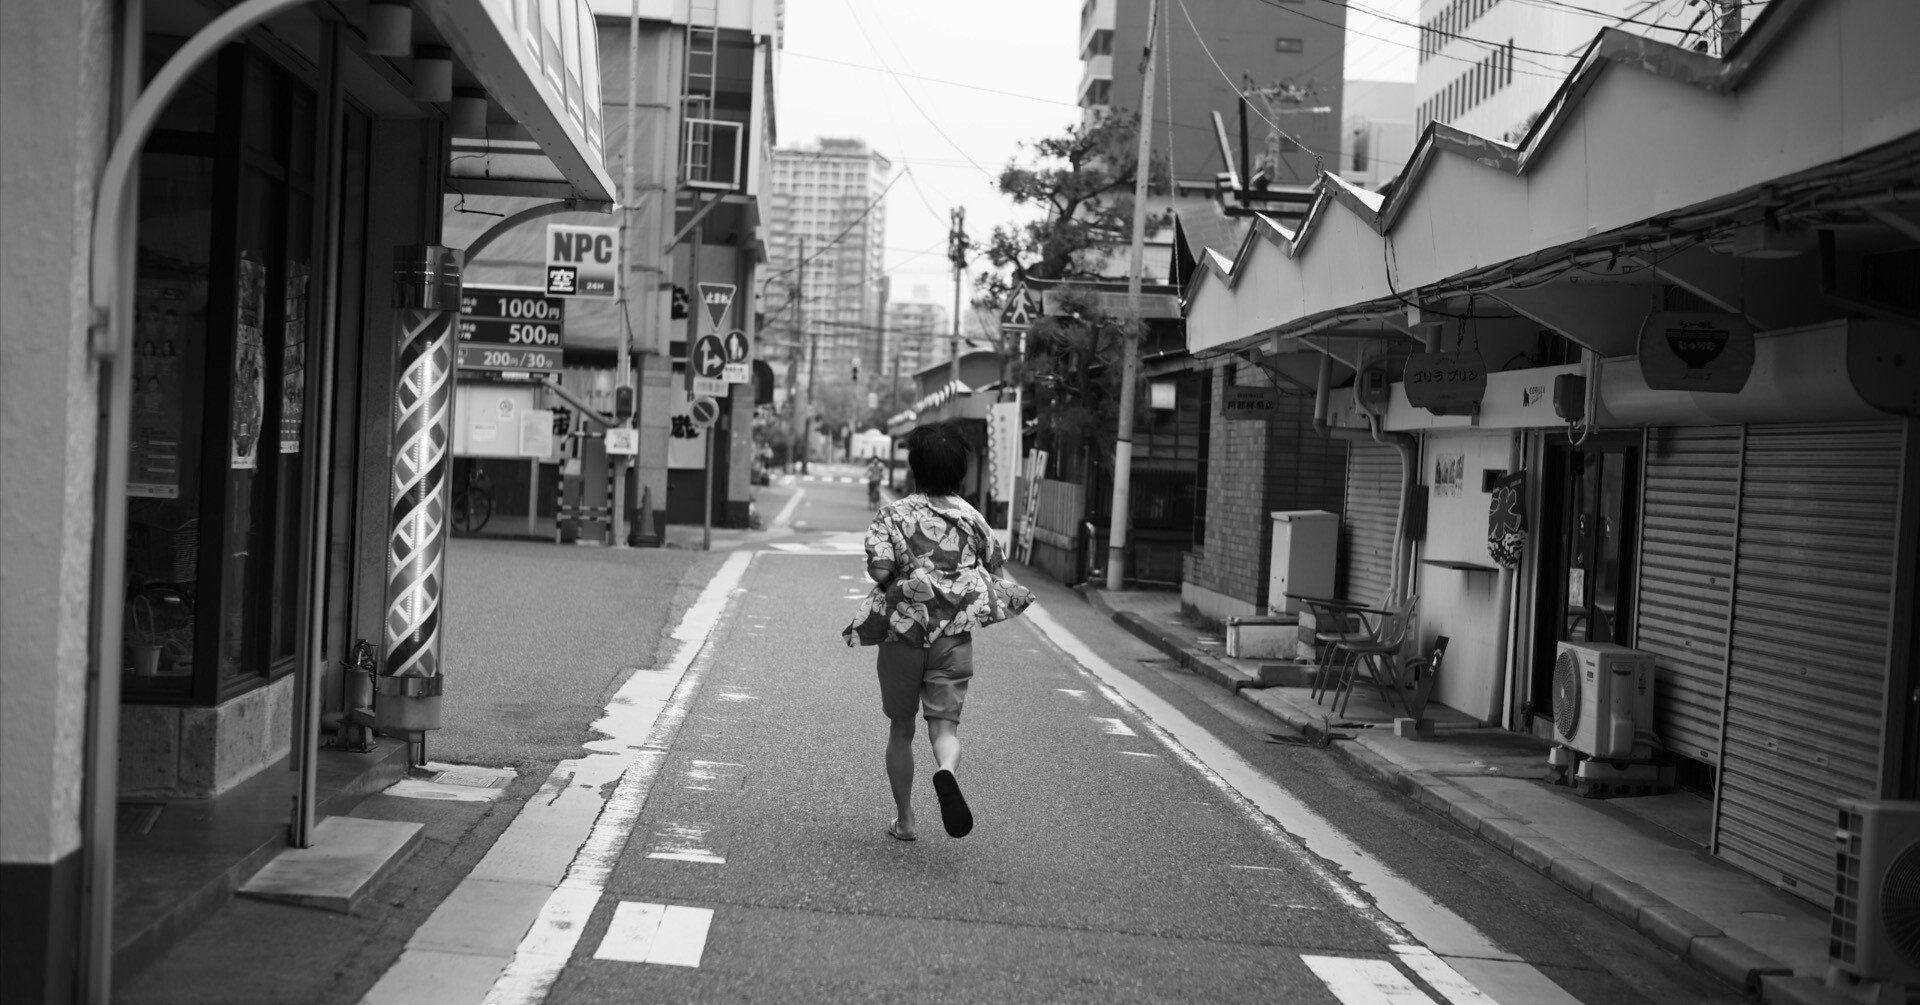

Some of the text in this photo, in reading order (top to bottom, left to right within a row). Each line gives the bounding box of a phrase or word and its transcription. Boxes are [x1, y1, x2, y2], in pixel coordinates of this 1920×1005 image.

[553, 232, 612, 264] NPC
[549, 268, 575, 292] 空
[586, 282, 604, 290] 24H
[498, 297, 560, 319] 1000円
[706, 291, 728, 304] 止まれ
[508, 323, 559, 345] 500円
[1413, 370, 1444, 383] ゴリラ
